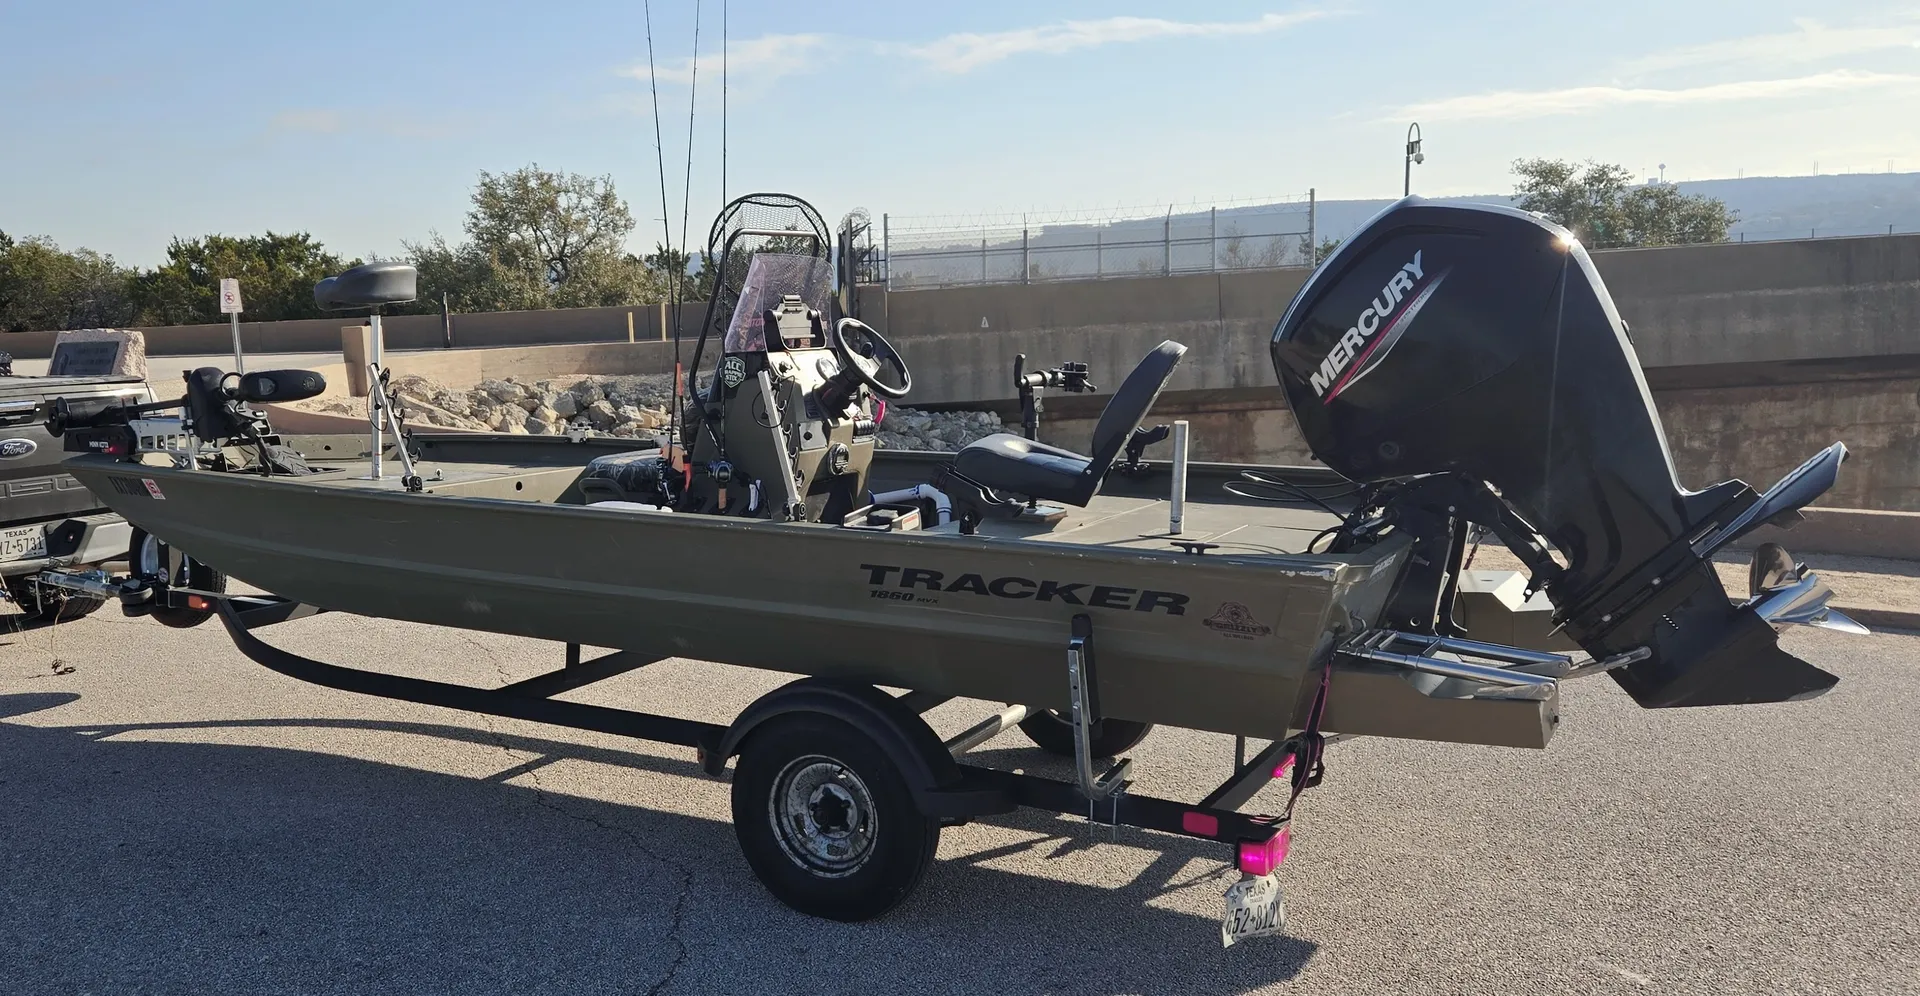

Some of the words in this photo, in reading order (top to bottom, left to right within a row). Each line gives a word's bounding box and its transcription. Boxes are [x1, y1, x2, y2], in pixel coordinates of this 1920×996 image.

[1309, 249, 1424, 397] MERCURY
[724, 360, 742, 372] ACC
[2, 442, 28, 456] Ford
[4, 529, 28, 538] TEXAS
[860, 563, 1190, 616] TRACKER
[870, 589, 915, 602] 1860
[916, 597, 939, 605] MVX
[1245, 883, 1266, 898] TEXAS
